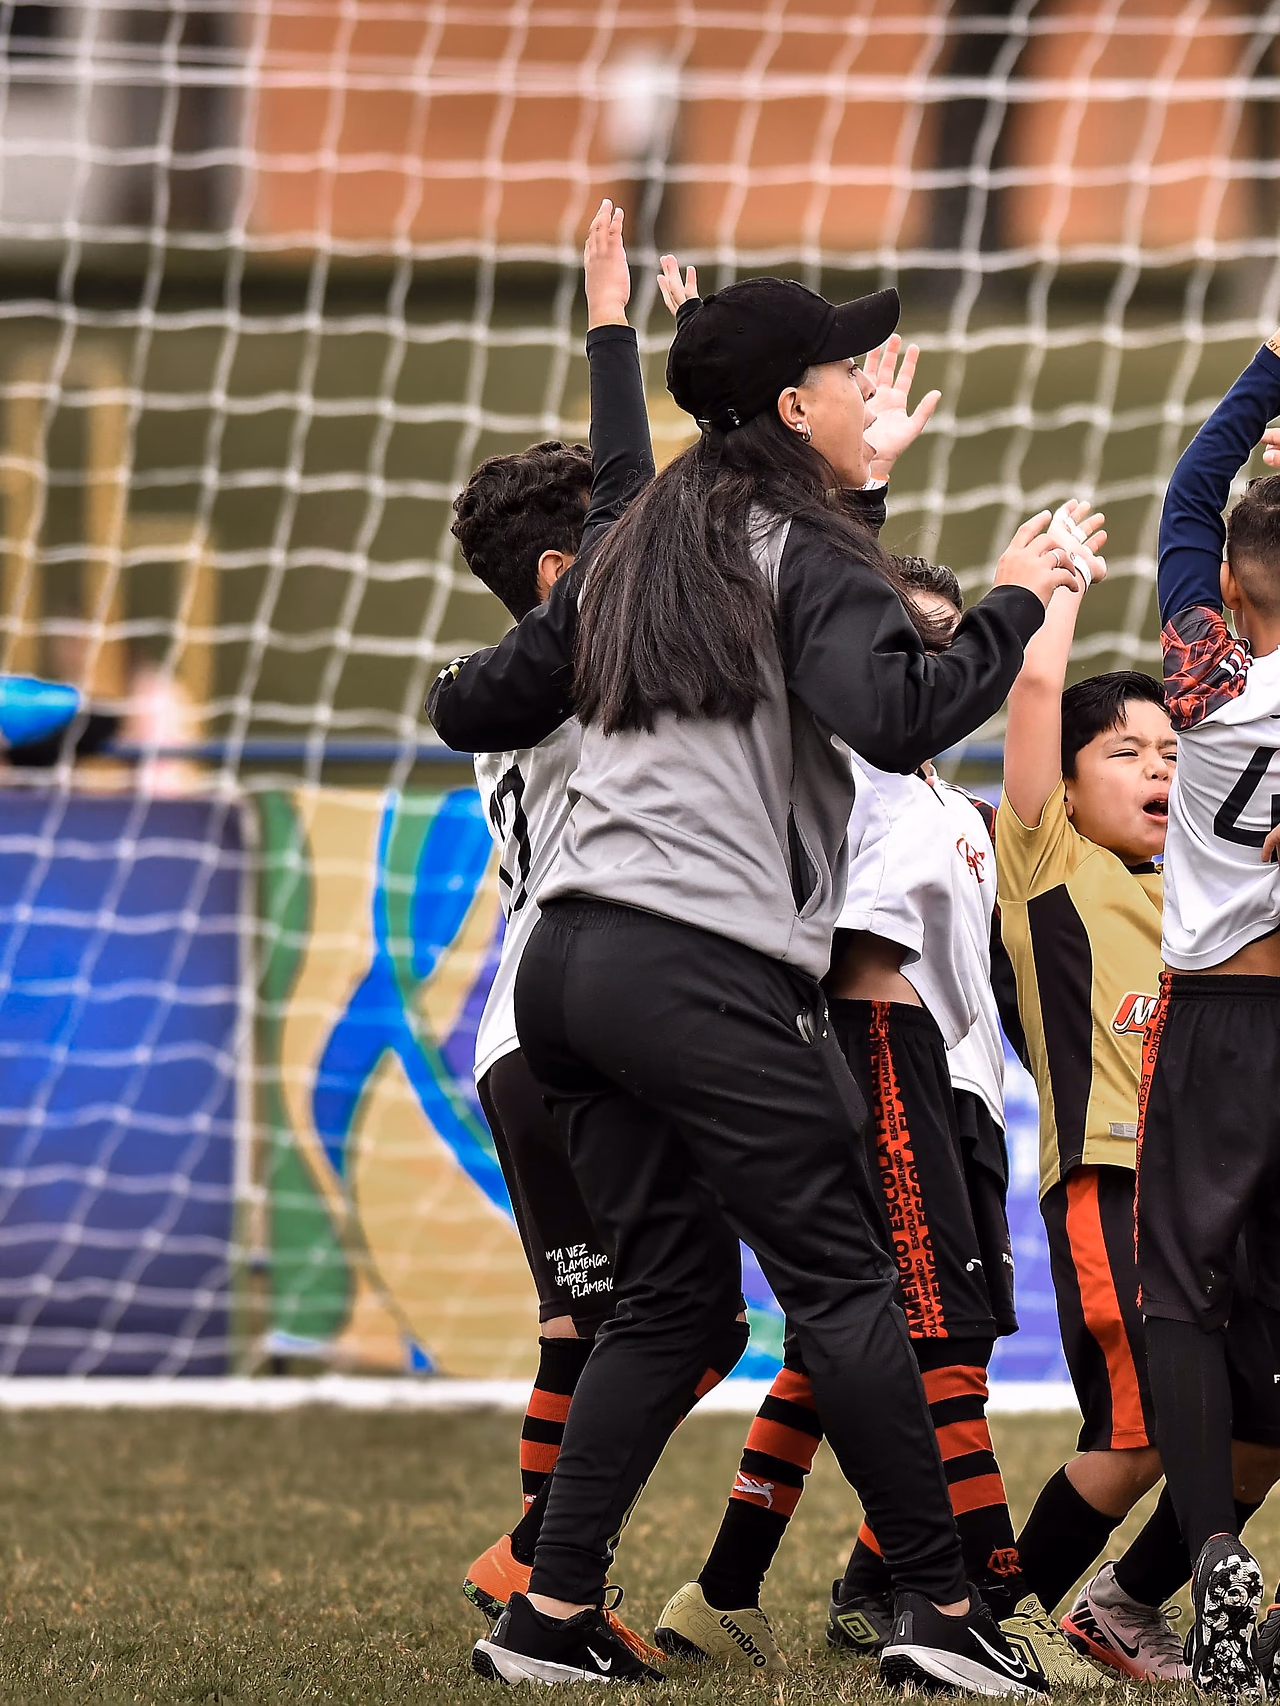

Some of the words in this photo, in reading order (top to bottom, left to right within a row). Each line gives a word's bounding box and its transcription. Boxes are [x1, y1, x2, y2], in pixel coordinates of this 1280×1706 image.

[879, 1036, 893, 1097] FLAMENGO
[886, 1098, 899, 1141] ESCOLA
[878, 1141, 905, 1231] ESCOLA
[894, 1149, 912, 1207] FLAMENGO
[565, 1243, 588, 1258] VEZ
[907, 1208, 920, 1250] ESCOLA
[555, 1270, 588, 1286] EMPRE
[557, 1253, 611, 1275] FLAMENGO,
[916, 1258, 935, 1315] FLAMENGO
[719, 1614, 767, 1668] umbro
